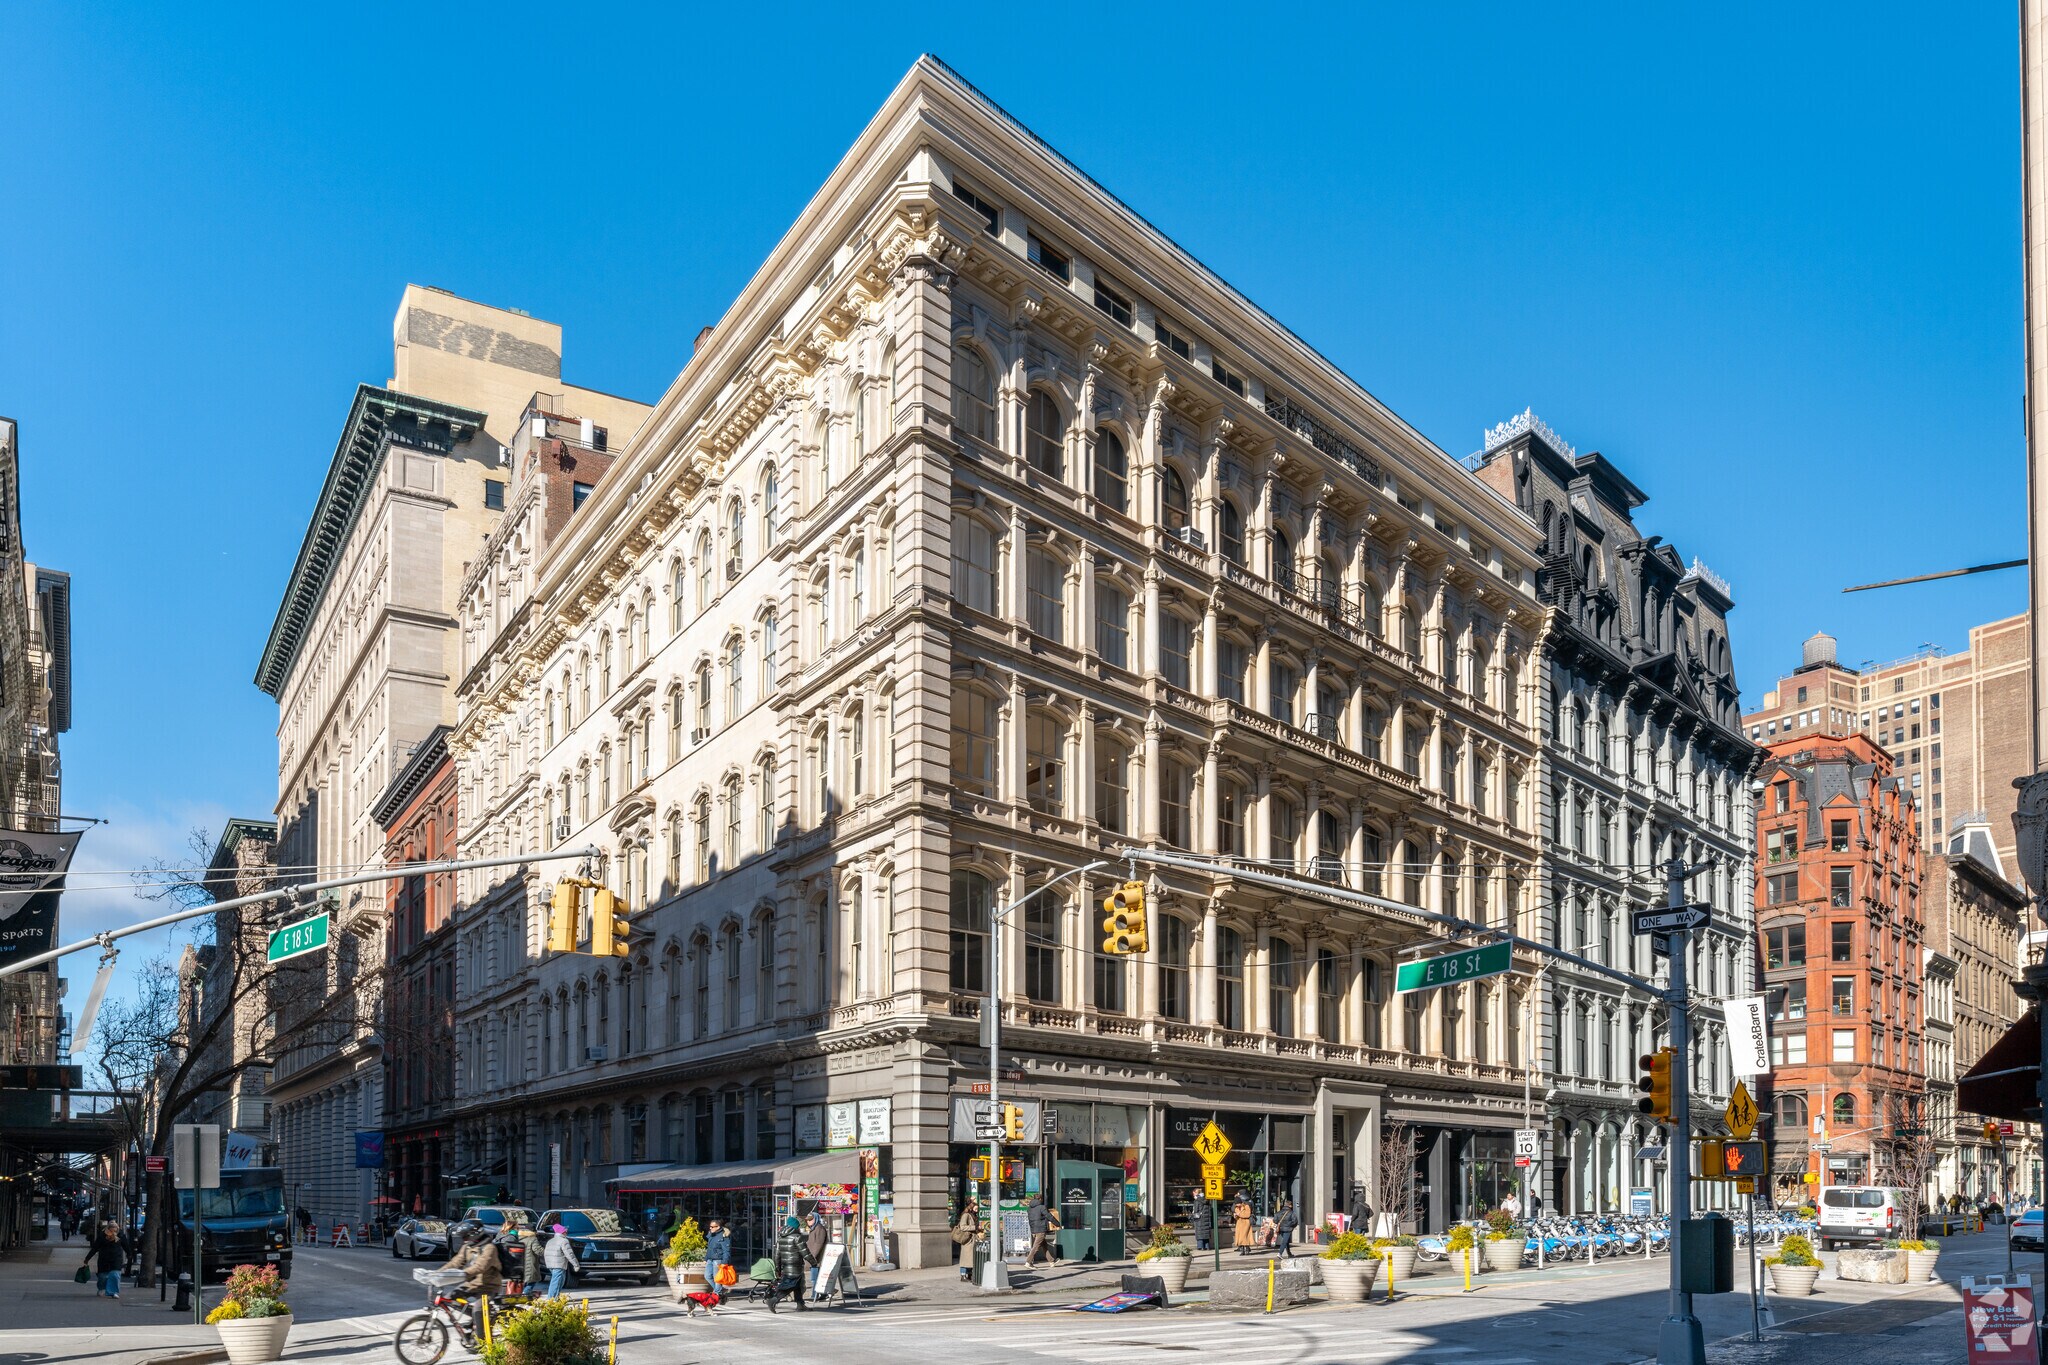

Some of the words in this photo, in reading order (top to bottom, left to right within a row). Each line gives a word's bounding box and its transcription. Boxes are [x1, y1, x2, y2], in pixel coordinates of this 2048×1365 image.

[2, 874, 34, 884] Broadway
[1641, 916, 1662, 928] ONE
[1675, 911, 1698, 923] WAY
[2, 928, 44, 940] SPORTS
[284, 933, 289, 952] E
[292, 929, 302, 949] 18
[304, 924, 313, 946] St
[1654, 938, 1664, 950] ONE
[1426, 964, 1435, 982] E
[1442, 959, 1458, 979] 18
[1465, 953, 1481, 974] St
[1747, 1003, 1766, 1068] Crate&Barrel
[973, 1084, 978, 1093] E
[978, 1084, 984, 1093] 18
[984, 1083, 990, 1092] St
[1175, 1121, 1191, 1131] OLE
[1192, 1122, 1199, 1132] &
[1519, 1143, 1533, 1153] 10
[971, 1182, 977, 1190] A
[1210, 1179, 1218, 1190] 5
[1997, 1305, 2019, 1313] Bed
[1972, 1314, 1991, 1322] For
[1993, 1314, 2005, 1322] $1
